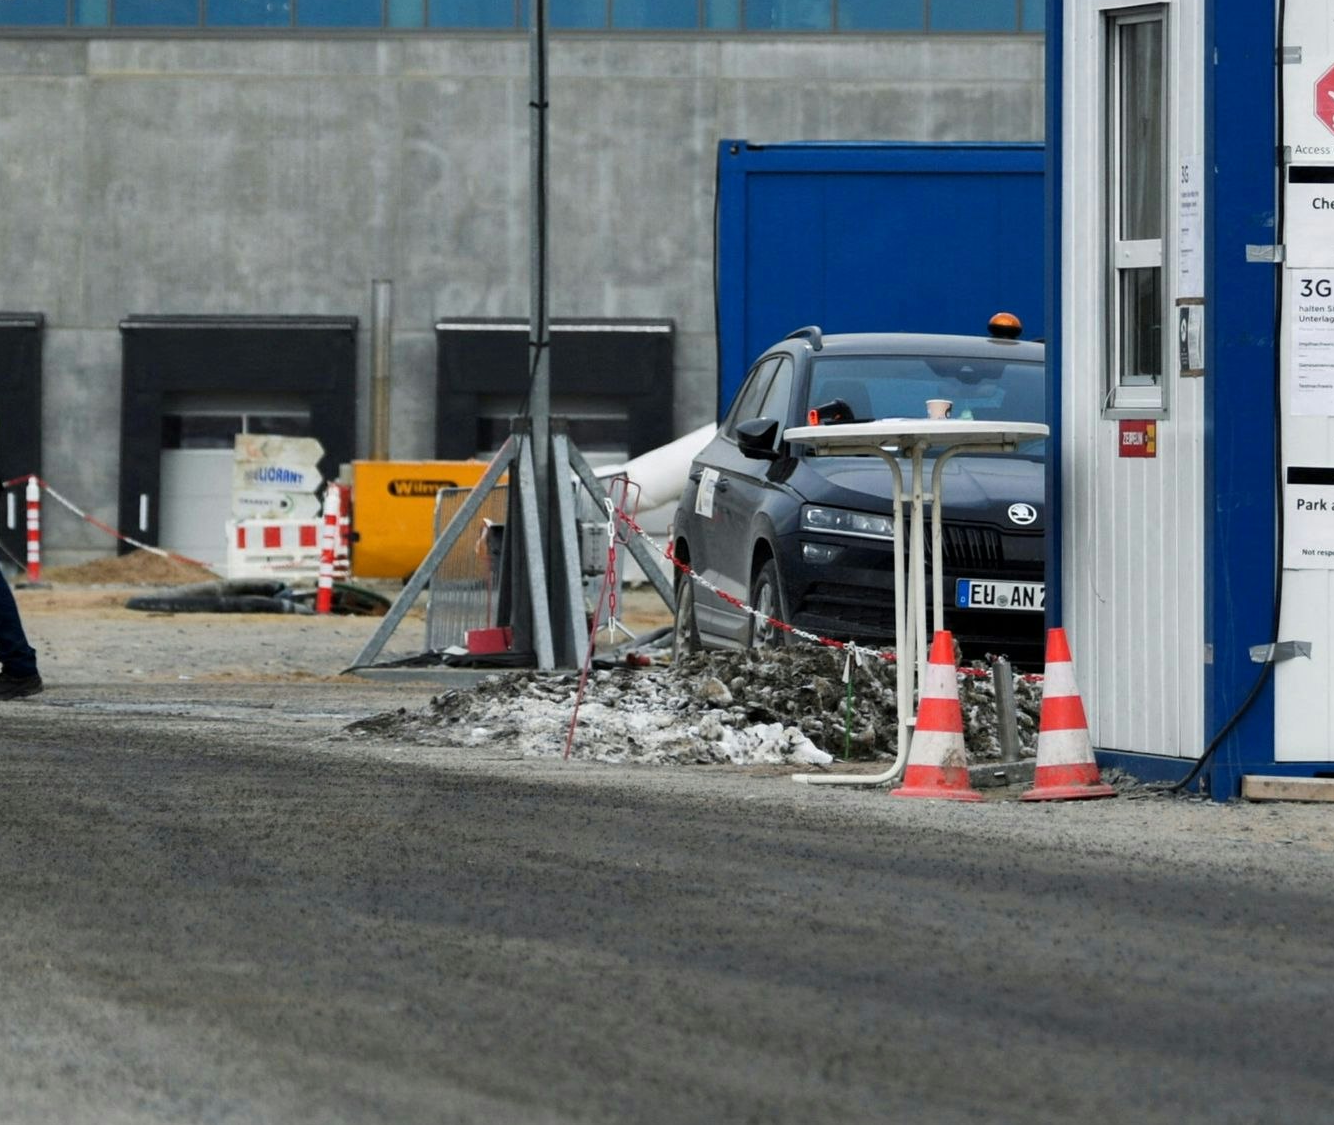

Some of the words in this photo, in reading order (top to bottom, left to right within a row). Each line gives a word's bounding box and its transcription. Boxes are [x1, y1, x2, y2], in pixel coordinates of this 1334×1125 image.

[1295, 145, 1331, 155] Access
[1300, 279, 1332, 297] 3G
[1299, 305, 1325, 313] halten
[1297, 498, 1327, 511] Park
[971, 584, 995, 605] EU
[1010, 586, 1035, 607] AN
